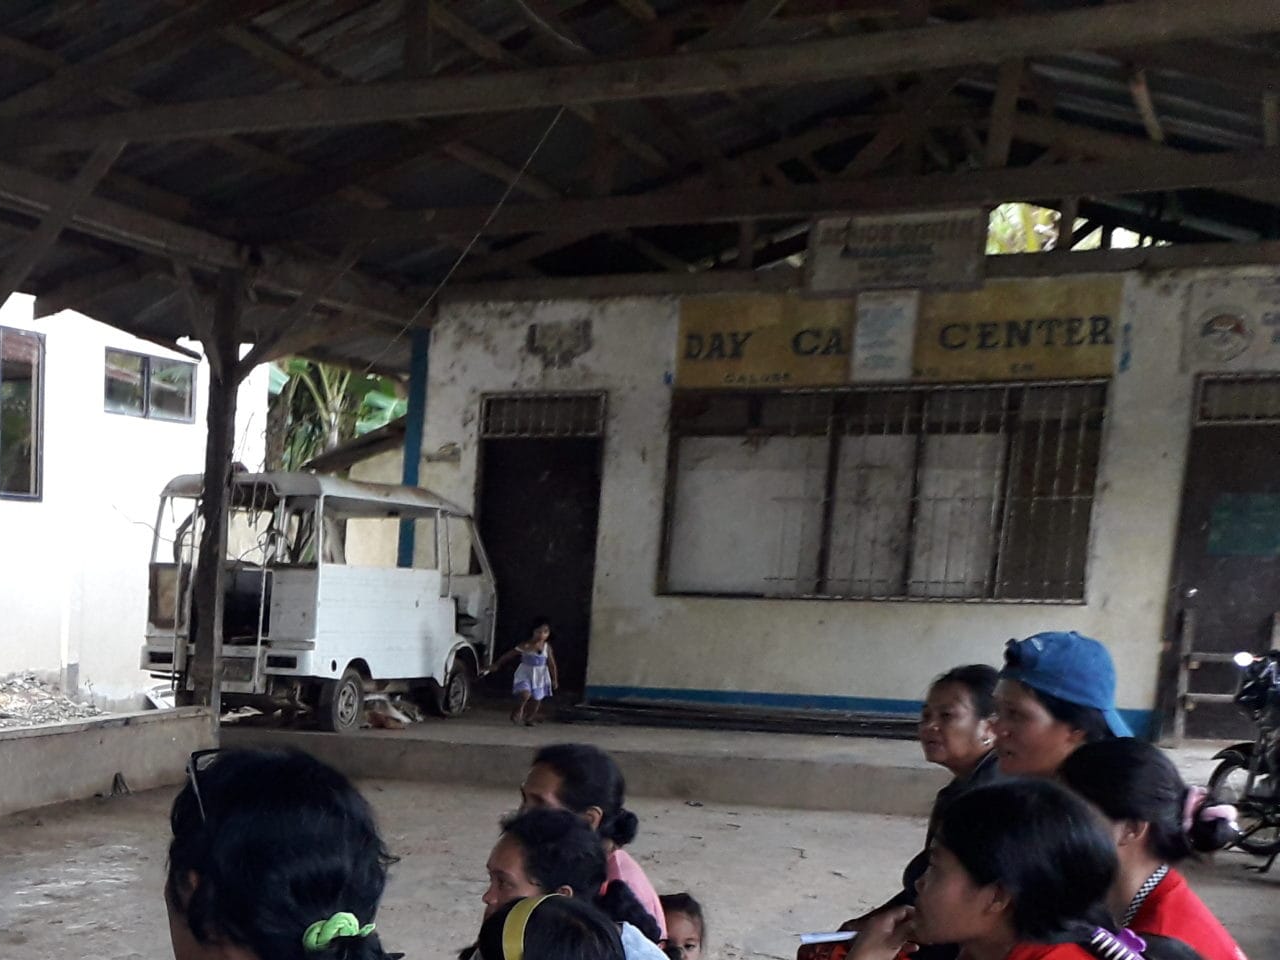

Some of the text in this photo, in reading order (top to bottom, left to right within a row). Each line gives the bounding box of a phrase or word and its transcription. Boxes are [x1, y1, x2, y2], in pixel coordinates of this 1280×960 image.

[684, 330, 753, 362] DAY
[790, 327, 848, 358] CA
[939, 314, 1117, 351] CENTER
